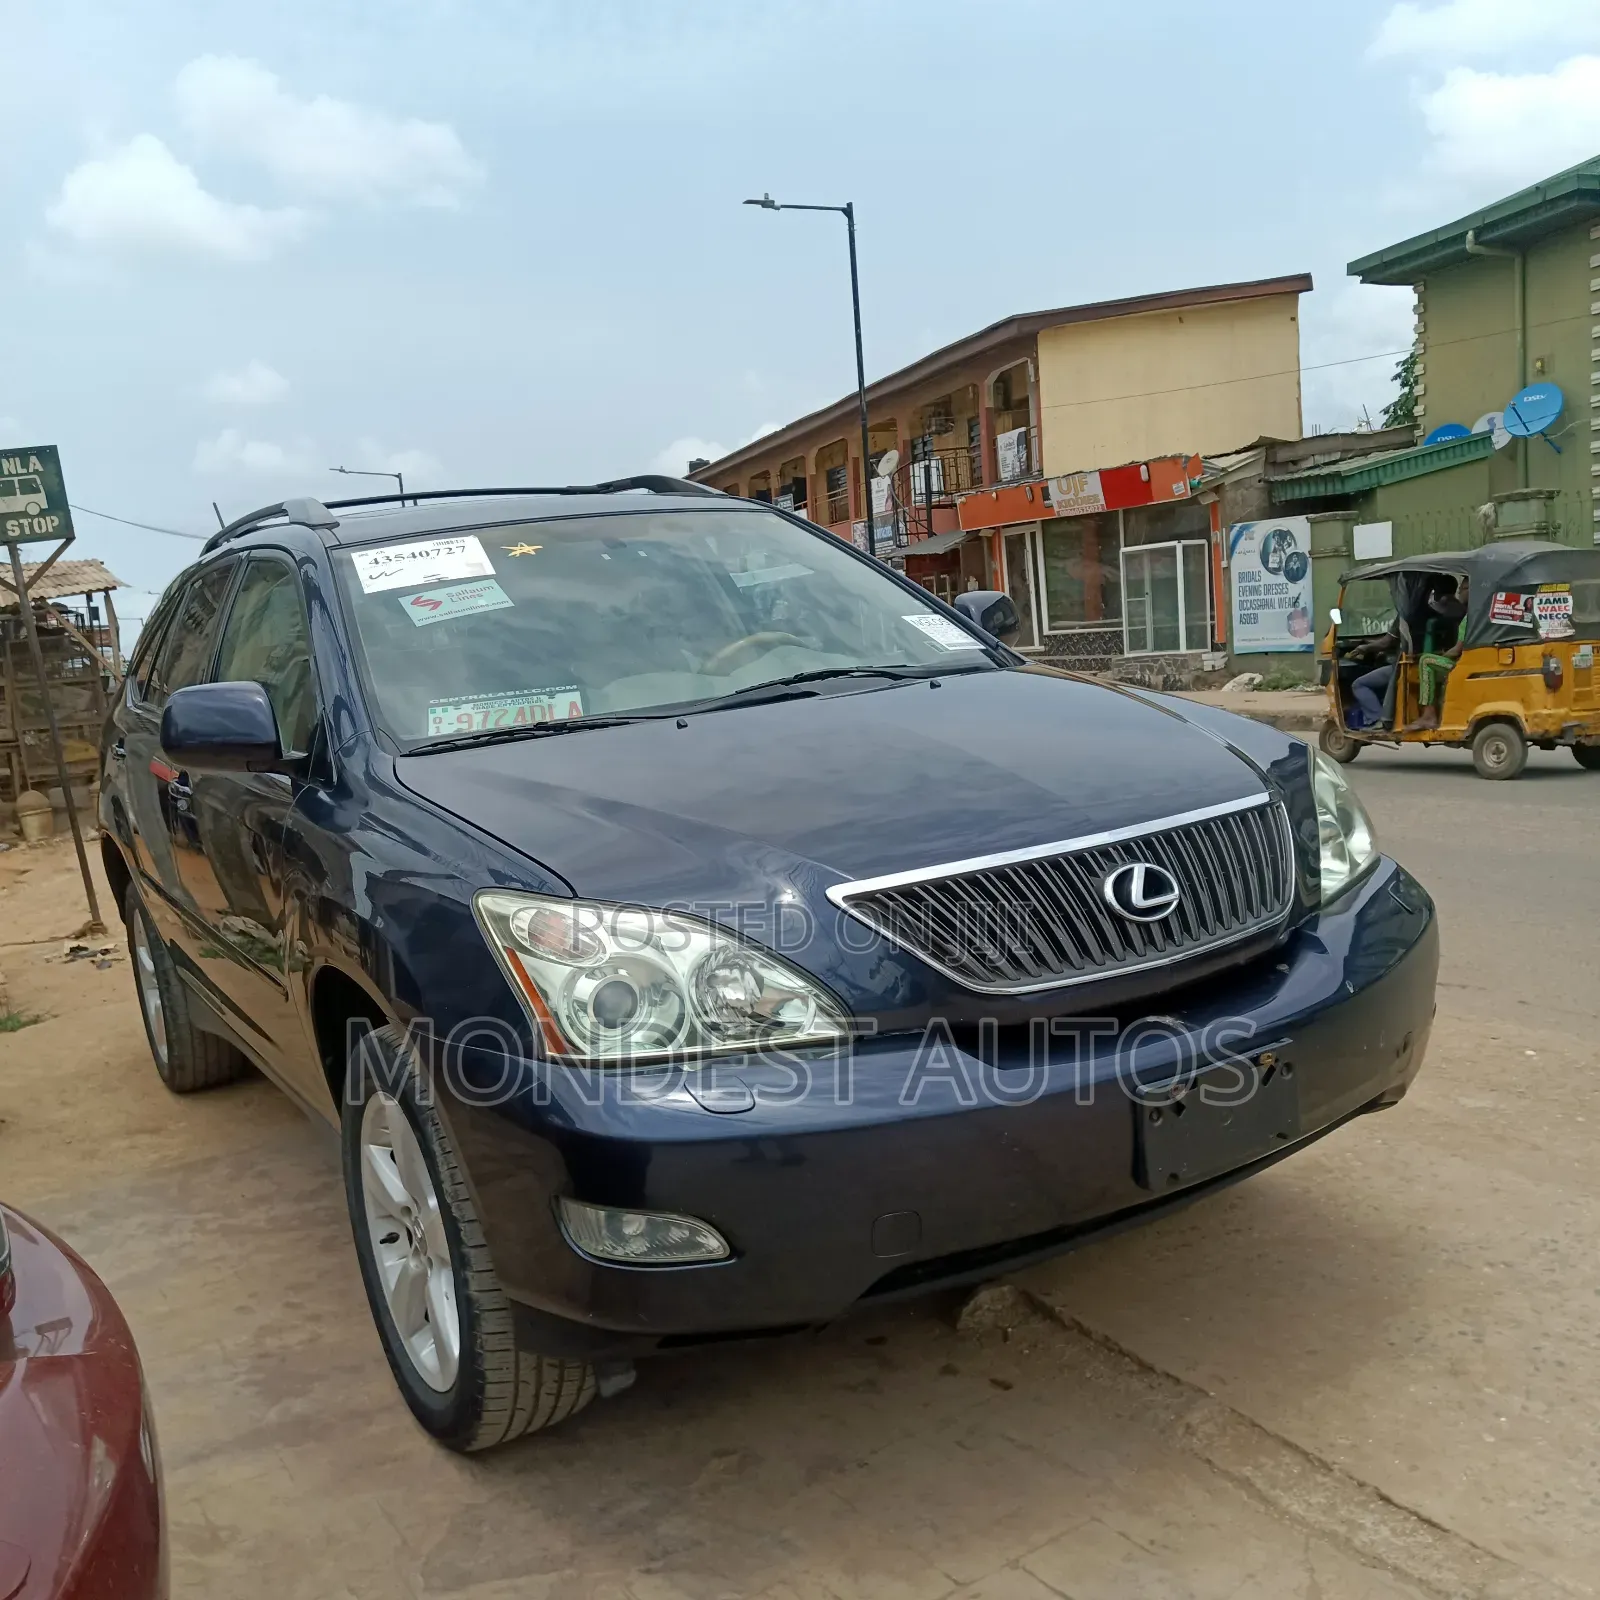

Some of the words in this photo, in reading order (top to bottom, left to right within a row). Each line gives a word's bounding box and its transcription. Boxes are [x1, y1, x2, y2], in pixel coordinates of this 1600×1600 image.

[1056, 474, 1088, 498] UJF
[6, 515, 60, 537] STOP
[368, 545, 466, 566] 43540727
[1238, 570, 1262, 584] BRIDALS
[446, 584, 494, 598] Sallaum
[1238, 585, 1262, 597] EVENING
[1263, 582, 1289, 596] DRESSES
[450, 593, 484, 603] Lines
[1536, 597, 1569, 605] JAMB
[1239, 612, 1259, 625] ASOEBI
[1538, 612, 1571, 620] NECO
